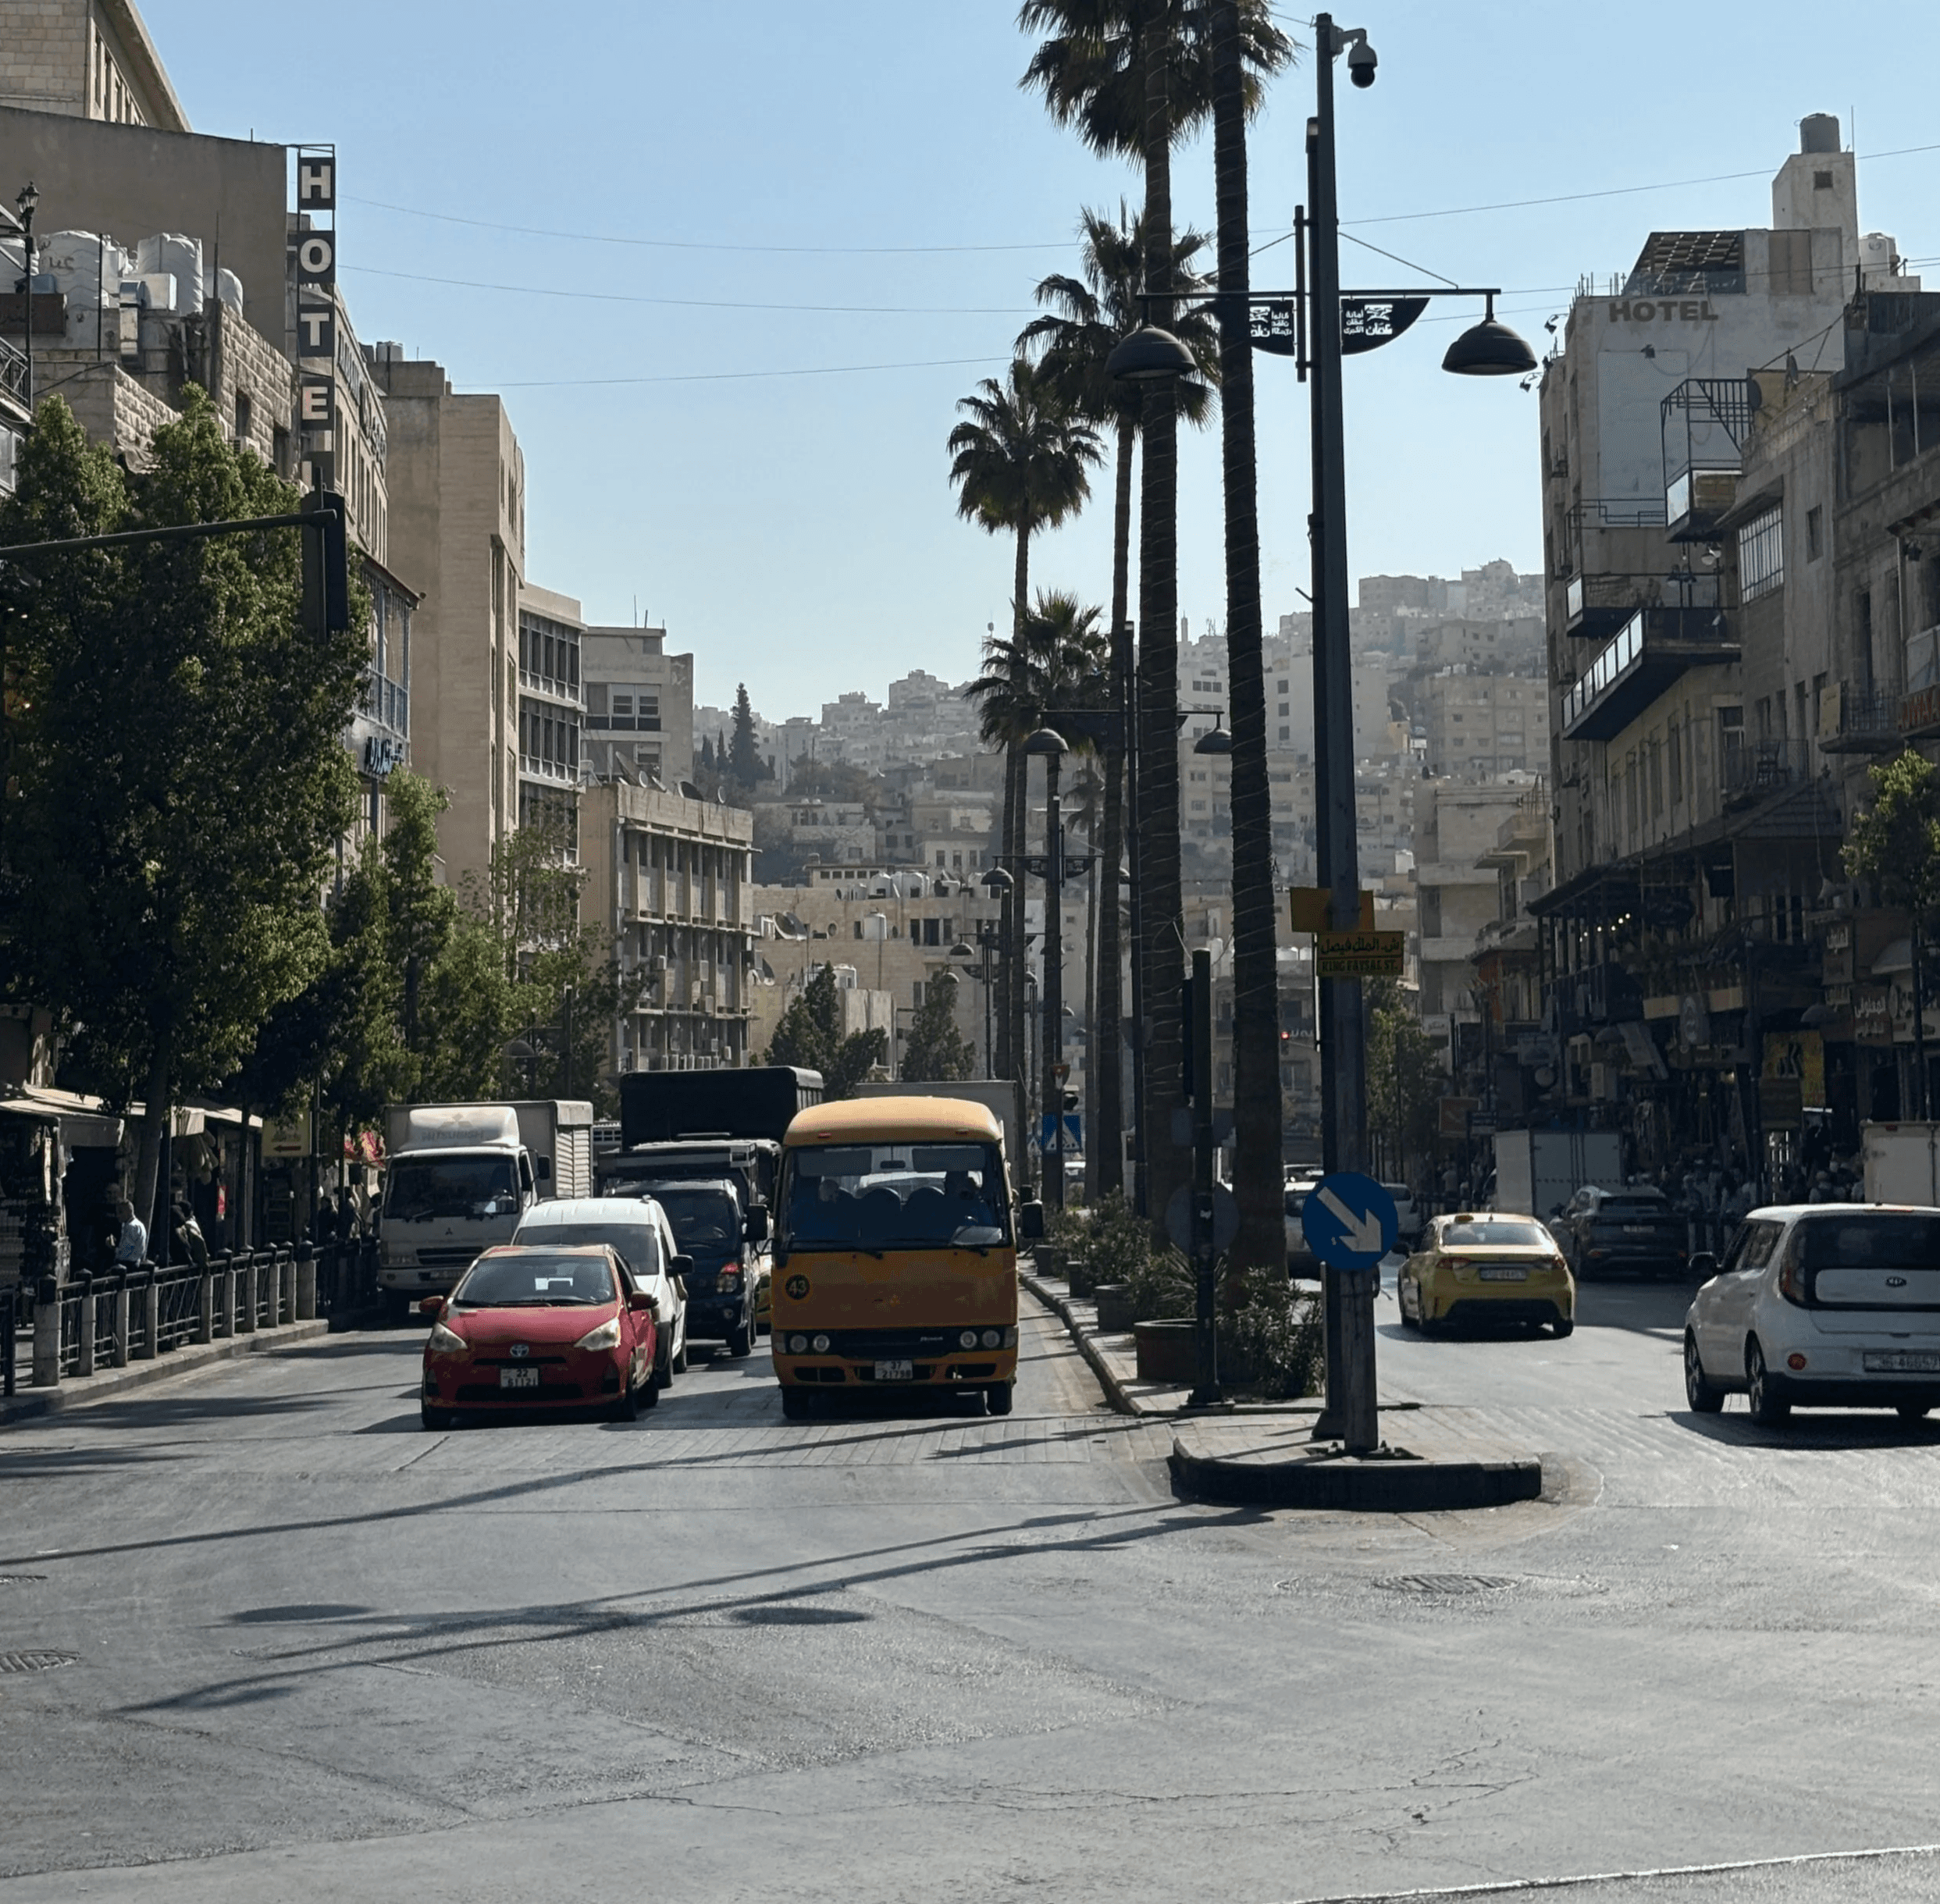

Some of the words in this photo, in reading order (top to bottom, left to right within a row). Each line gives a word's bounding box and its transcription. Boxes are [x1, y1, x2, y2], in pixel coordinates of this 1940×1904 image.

[1608, 301, 1719, 323] HOTEL
[1321, 937, 1352, 955] فيصل
[1353, 936, 1379, 952] الملك
[1322, 959, 1344, 972] KING
[1347, 959, 1382, 971] FAYSAL
[788, 1279, 806, 1295] 43
[517, 1368, 529, 1377] 22
